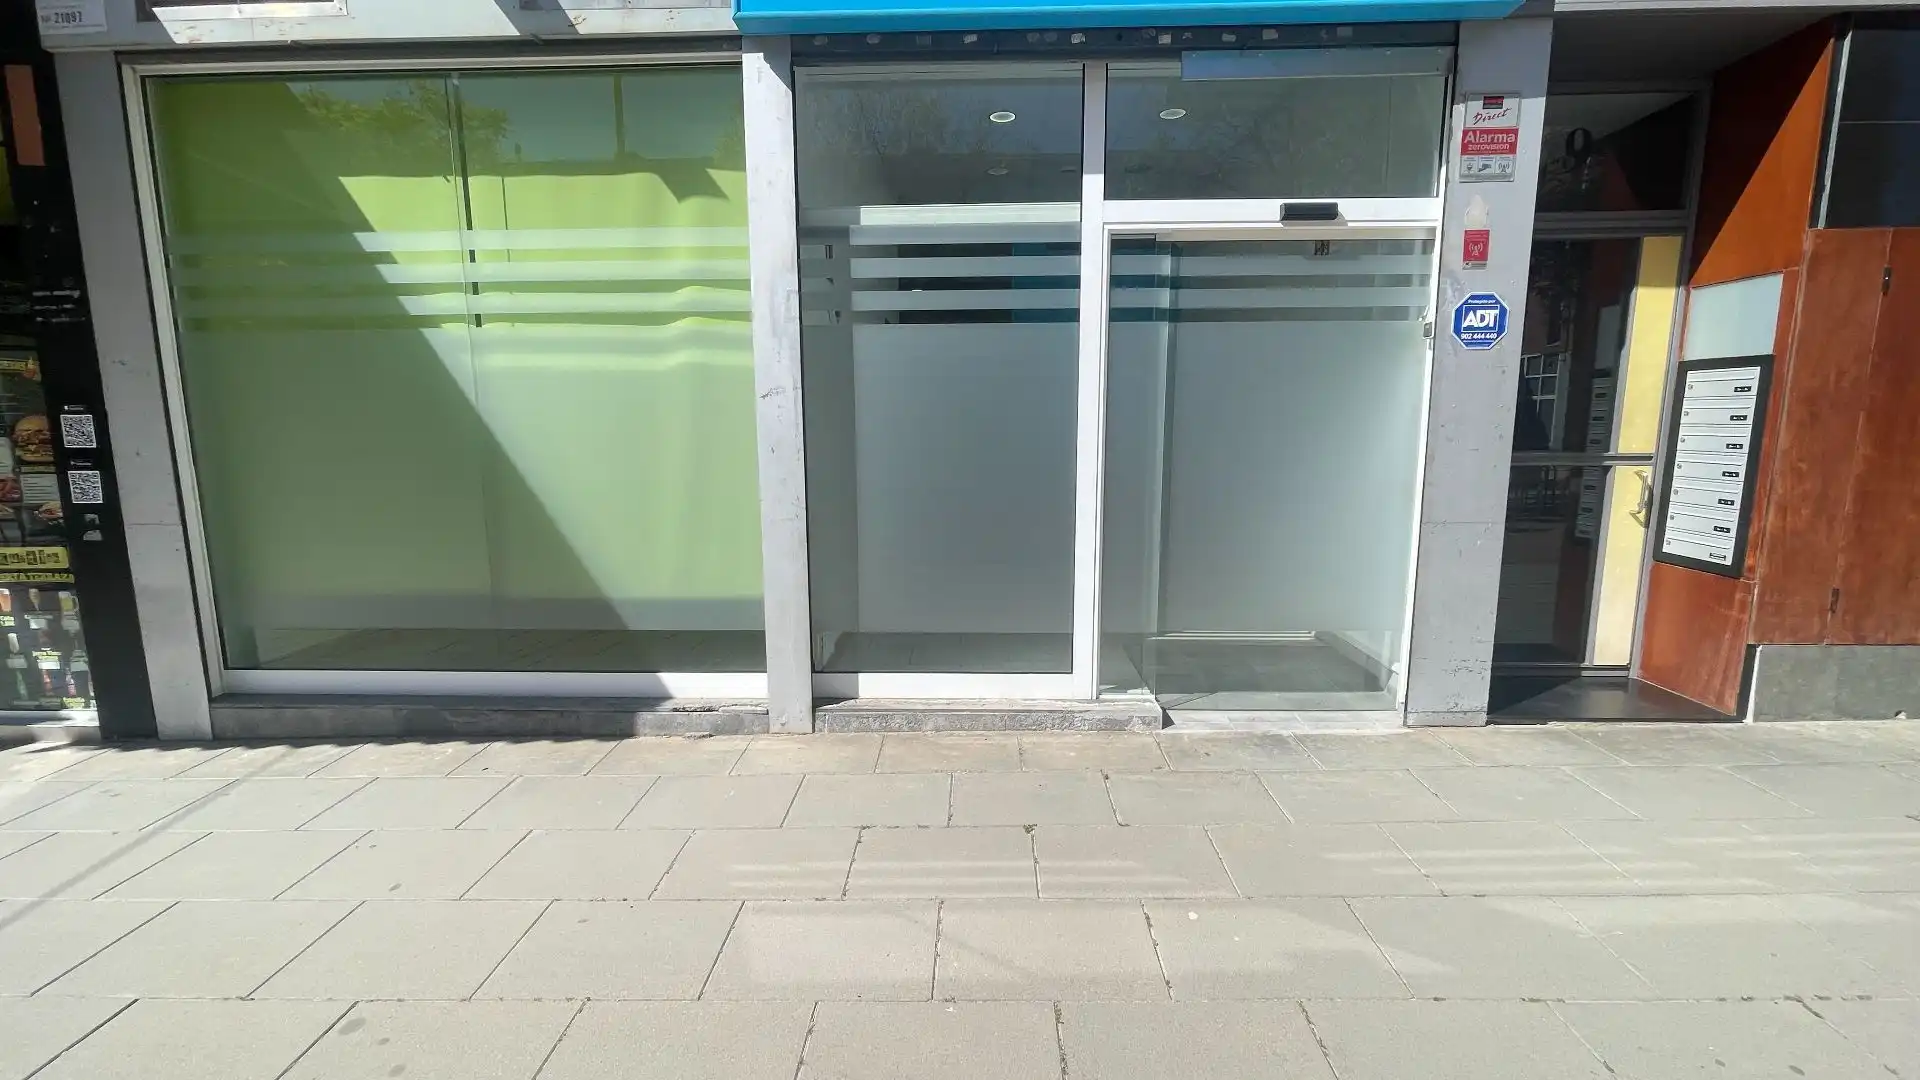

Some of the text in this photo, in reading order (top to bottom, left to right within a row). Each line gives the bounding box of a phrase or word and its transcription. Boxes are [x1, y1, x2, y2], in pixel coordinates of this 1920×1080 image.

[1473, 107, 1512, 125] Direct
[1463, 130, 1516, 143] Alarma
[1467, 143, 1510, 151] zerovision
[1463, 309, 1499, 327] ADT
